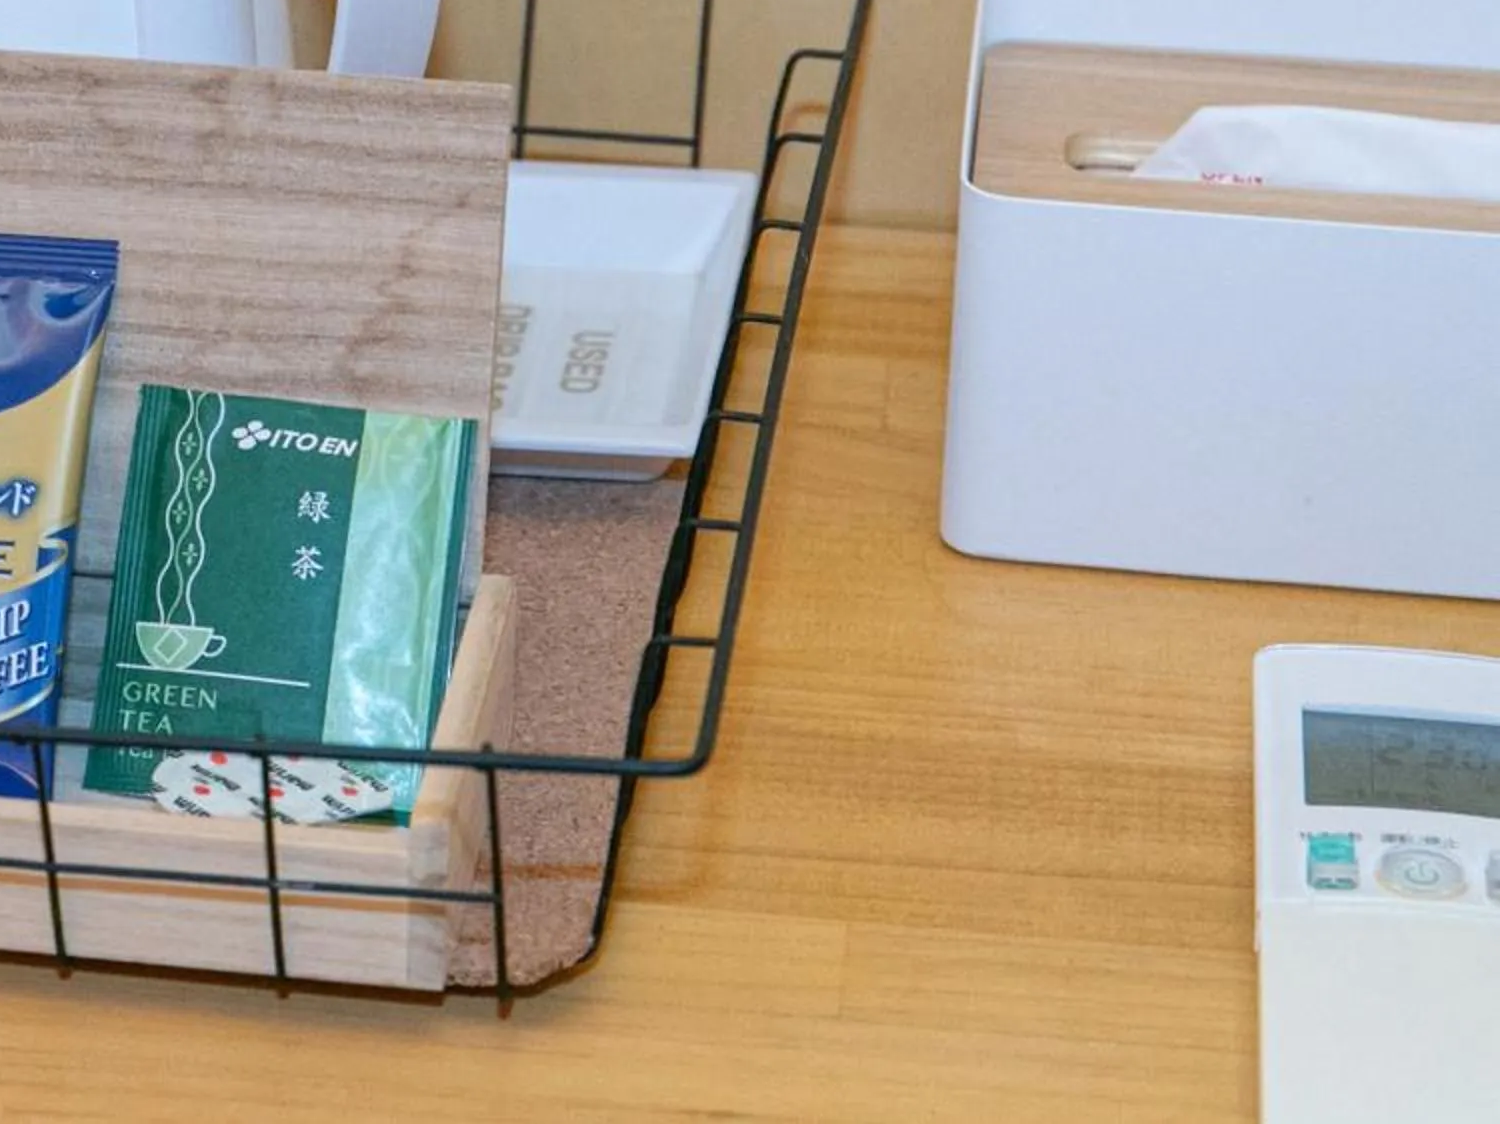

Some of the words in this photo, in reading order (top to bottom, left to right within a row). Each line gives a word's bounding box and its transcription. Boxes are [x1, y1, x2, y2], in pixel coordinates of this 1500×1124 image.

[559, 330, 615, 394] USED
[122, 681, 218, 709] GREEN
[120, 709, 173, 735] TEA
